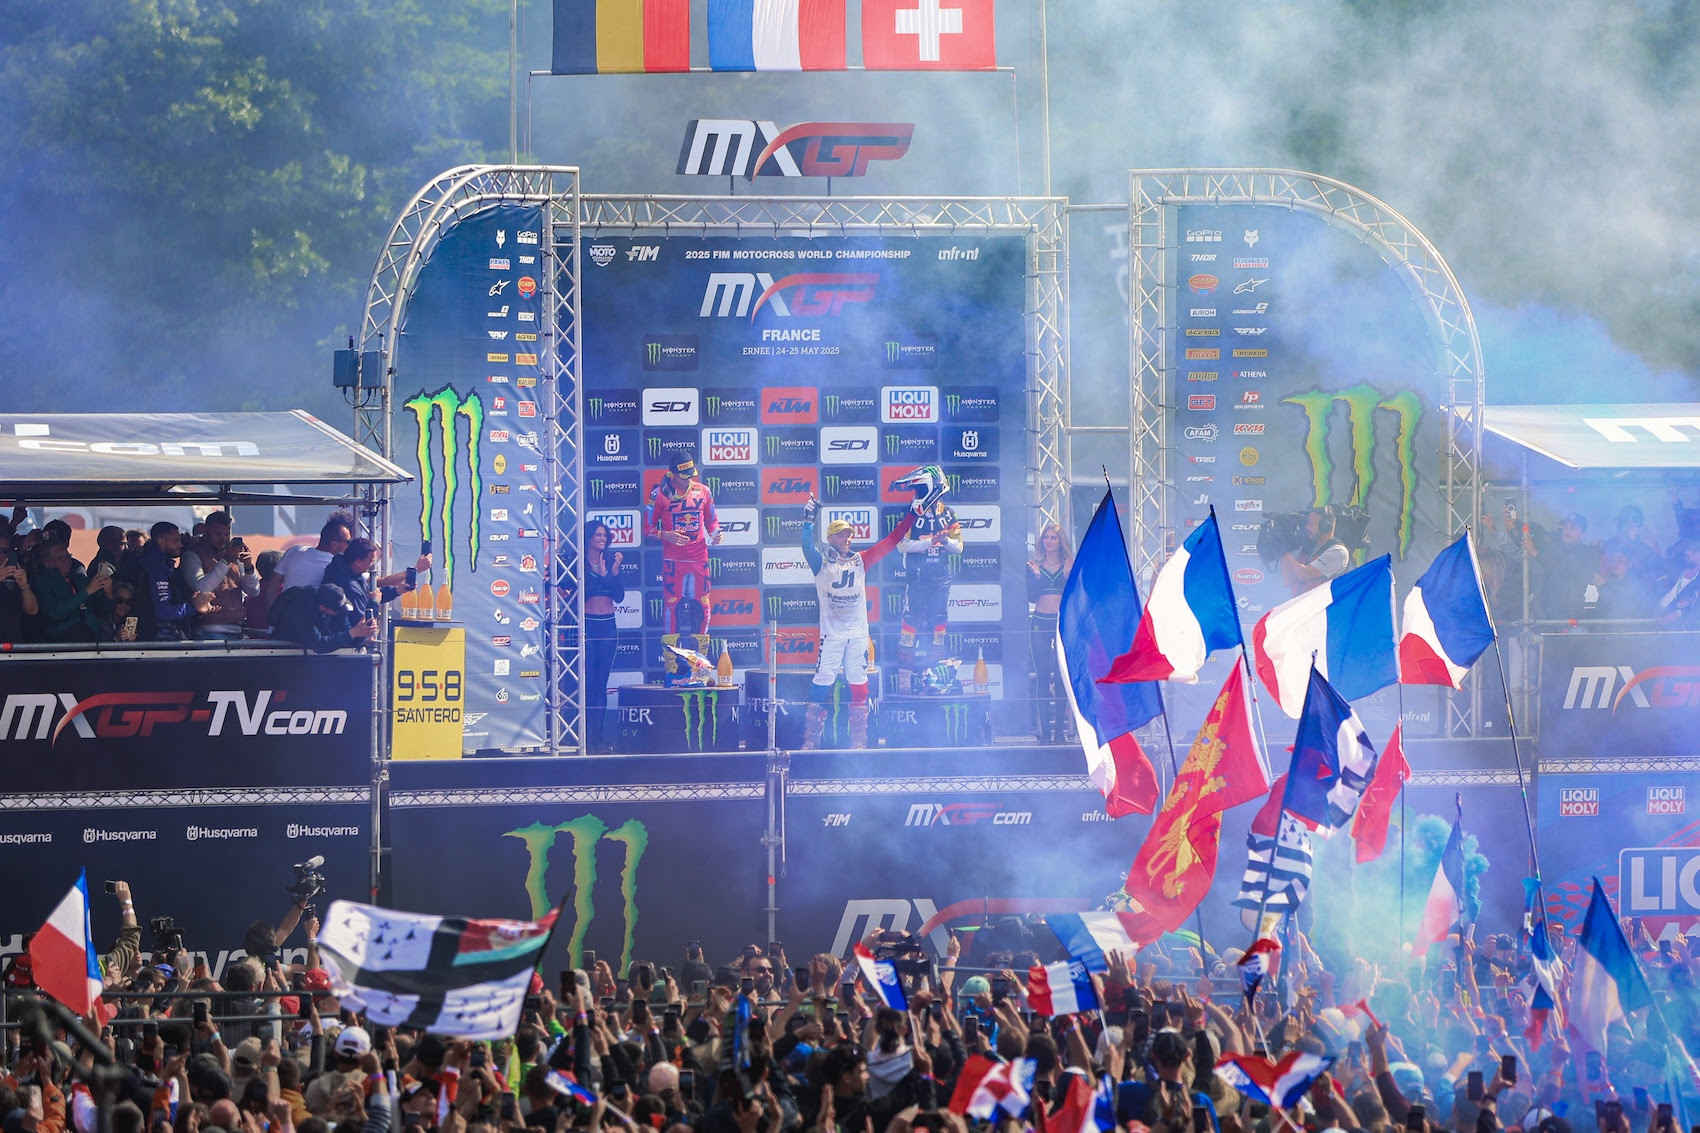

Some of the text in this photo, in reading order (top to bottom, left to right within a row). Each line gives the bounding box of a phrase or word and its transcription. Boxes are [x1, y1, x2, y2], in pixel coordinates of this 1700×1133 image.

[688, 119, 915, 184] MXGP
[589, 248, 616, 257] MOTO
[625, 246, 660, 261] FIM
[685, 250, 911, 259] 2025 FIM MOTOCROSS WORLD CHAMPIONSHIP
[699, 272, 881, 322] MXGP
[762, 329, 821, 342] FRANCE
[742, 347, 840, 356] ERNEE 24-25 MAY 2025
[890, 391, 930, 404] LIQUI
[767, 397, 811, 414] KTM
[890, 405, 930, 418] MOLY
[711, 432, 750, 447] LIQUI
[596, 454, 629, 463] Husqvarna
[710, 447, 750, 461] MOLY
[953, 450, 987, 458] Husqvarna
[767, 477, 811, 494] KTM
[668, 498, 704, 512] FLY
[596, 515, 632, 529] IQUI
[854, 525, 869, 538] LY
[831, 569, 855, 589] J1
[712, 600, 754, 615] KTM
[397, 708, 461, 723] SANTERO
[1401, 711, 1431, 722] nfront
[1562, 789, 1597, 802] LIQUI
[1649, 788, 1683, 801] LIQUI
[1562, 802, 1598, 815] MOLY
[1649, 801, 1683, 814] MOLY
[822, 813, 851, 827] FIM
[96, 829, 157, 842] Husqvarna
[199, 826, 258, 840] Husqvarna
[299, 824, 359, 839] Husqvarna
[0, 832, 52, 845] usqvarna
